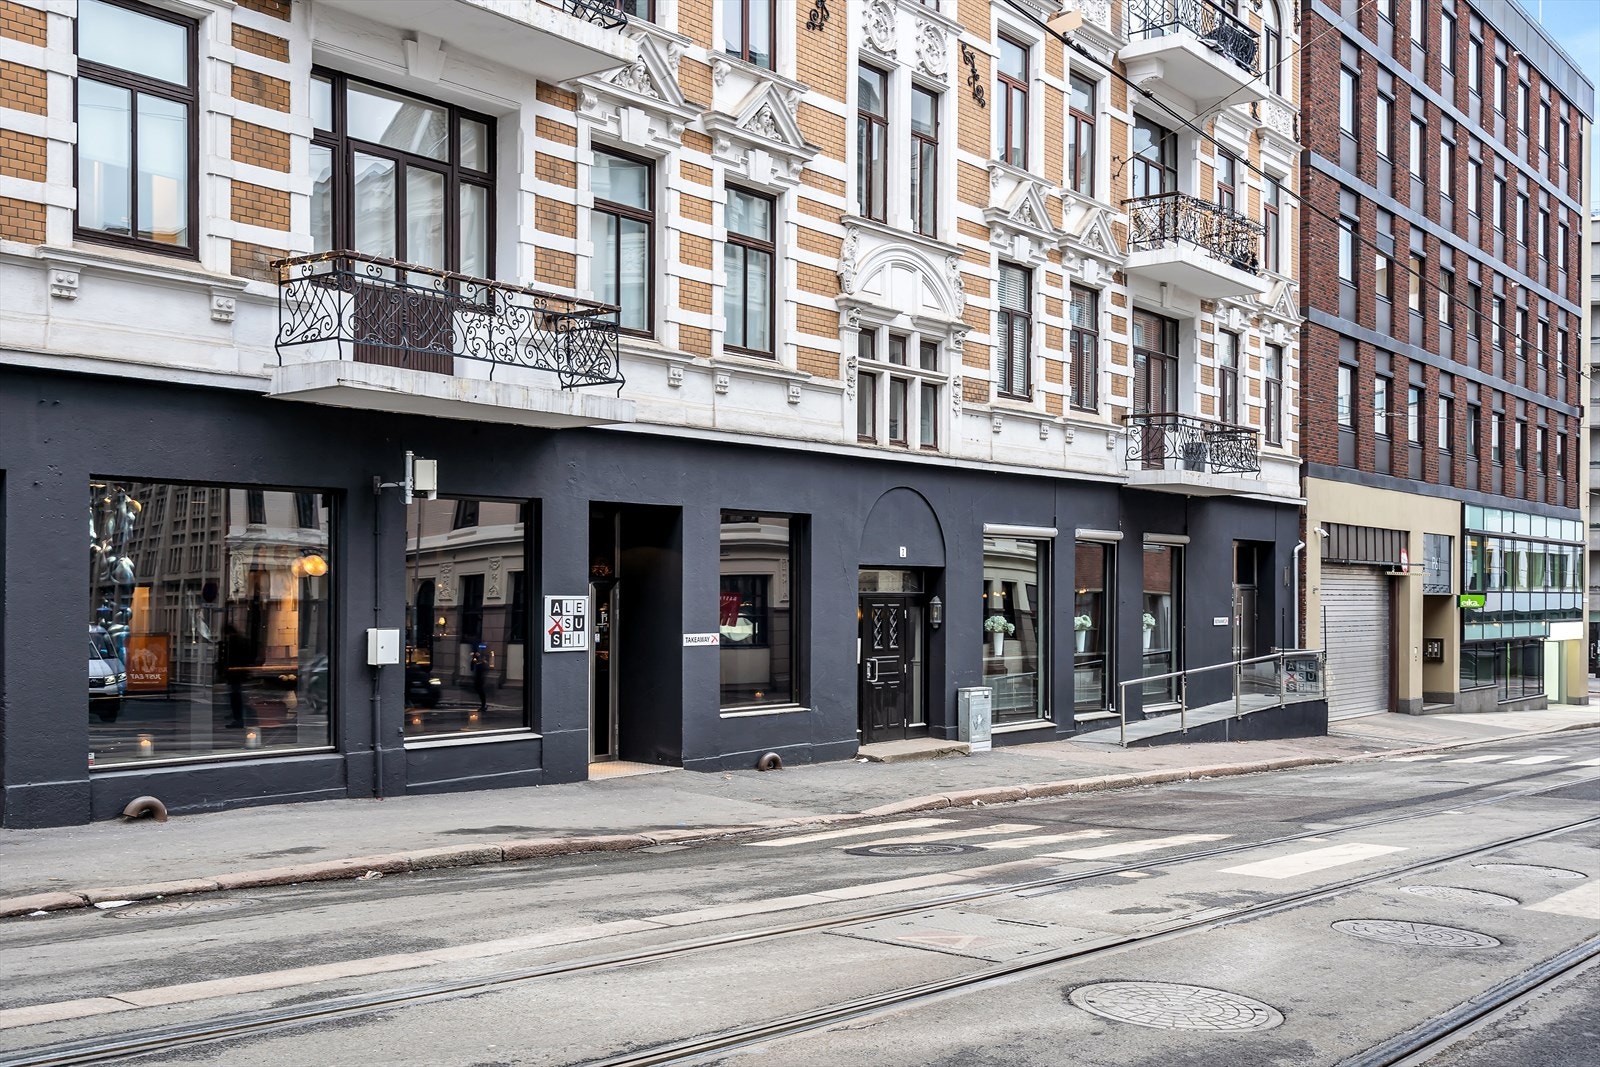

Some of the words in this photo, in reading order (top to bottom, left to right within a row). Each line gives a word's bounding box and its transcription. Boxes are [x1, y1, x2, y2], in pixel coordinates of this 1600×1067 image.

[553, 602, 583, 614] ALE
[553, 633, 580, 645] SHI
[685, 636, 711, 645] TAKEAWAY
